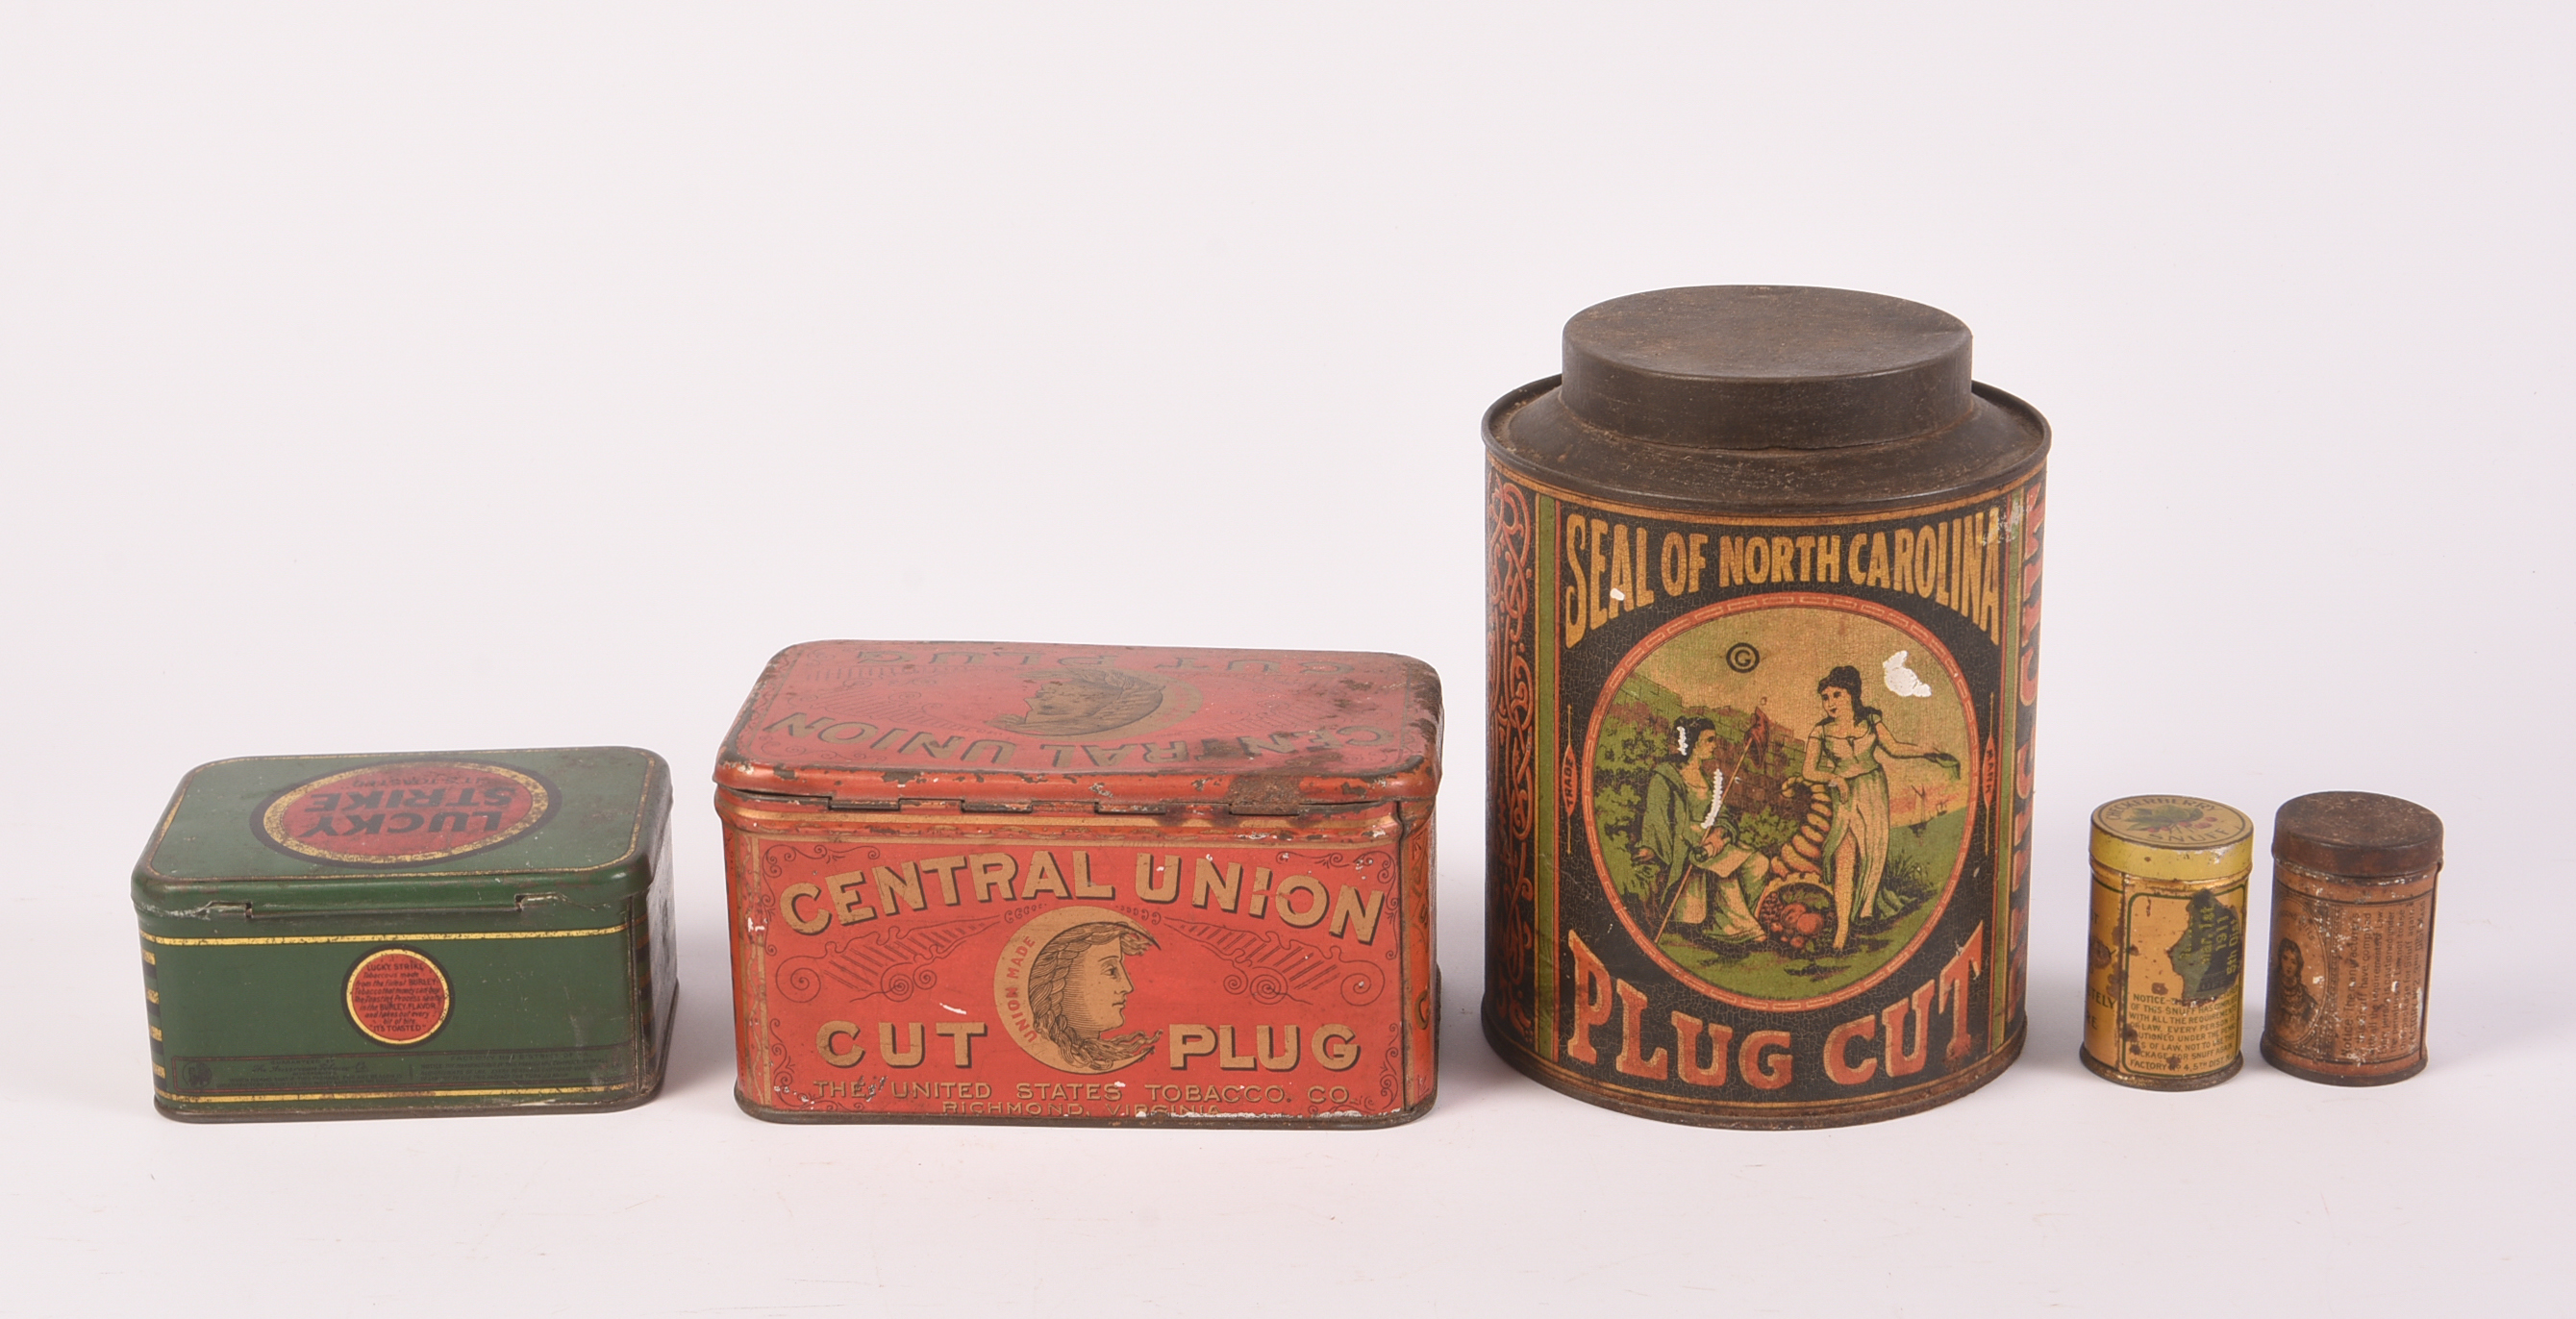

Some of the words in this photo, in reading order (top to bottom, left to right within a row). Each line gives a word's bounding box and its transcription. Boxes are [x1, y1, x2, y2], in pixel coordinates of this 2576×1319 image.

[1565, 513, 1655, 649] SEAL
[1661, 532, 1709, 597] OF
[1719, 535, 1840, 587] NORTH
[1848, 507, 2000, 646] CAROLINA
[763, 712, 1016, 764] UNION
[304, 786, 515, 812] STRIKE
[2105, 797, 2221, 821] CHECKERBERRY
[297, 809, 503, 838] LUCKY
[2146, 827, 2230, 842] SNUFF
[780, 850, 1115, 935] CENTRAL
[1135, 852, 1386, 946] UNION
[2215, 915, 2229, 951] 1911
[1006, 935, 1036, 980] MADE
[2226, 950, 2238, 975] 5th
[2346, 913, 2359, 991] manuacturers
[2384, 939, 2392, 984] cautioned
[2404, 941, 2413, 968] Snuff
[394, 962, 424, 971] STRIKE
[2358, 966, 2368, 988] have
[1005, 986, 1038, 1043] UNION
[1567, 929, 1793, 1090] PLUG
[1823, 919, 1984, 1085] CUT
[2143, 1005, 2163, 1014] THIS
[2165, 1006, 2197, 1016] SNUFF
[2198, 1005, 2213, 1013] HAS
[2343, 994, 2355, 1012] The
[2381, 997, 2390, 1029] person
[2129, 1011, 2150, 1021] WITH
[2152, 1014, 2168, 1023] ALL
[2169, 1016, 2187, 1025] THE
[2199, 1019, 2229, 1031] PERSON
[2367, 1022, 2377, 1033] all
[815, 1020, 988, 1069] CUT
[1169, 1023, 1361, 1072] PLUG
[2132, 1032, 2175, 1042] UTIONED
[2178, 1033, 2206, 1042] UNDER
[2149, 1040, 2159, 1050] OF
[2185, 1043, 2201, 1052] NOT
[2129, 1050, 2168, 1059] CKAGE
[2192, 1050, 2214, 1059] SNUFF
[2130, 1058, 2167, 1070] FACTORY
[813, 1081, 865, 1098] THE
[890, 1081, 992, 1100] UNITED
[1016, 1082, 1122, 1101] STATES
[942, 1101, 1091, 1116] RICHMOND,
